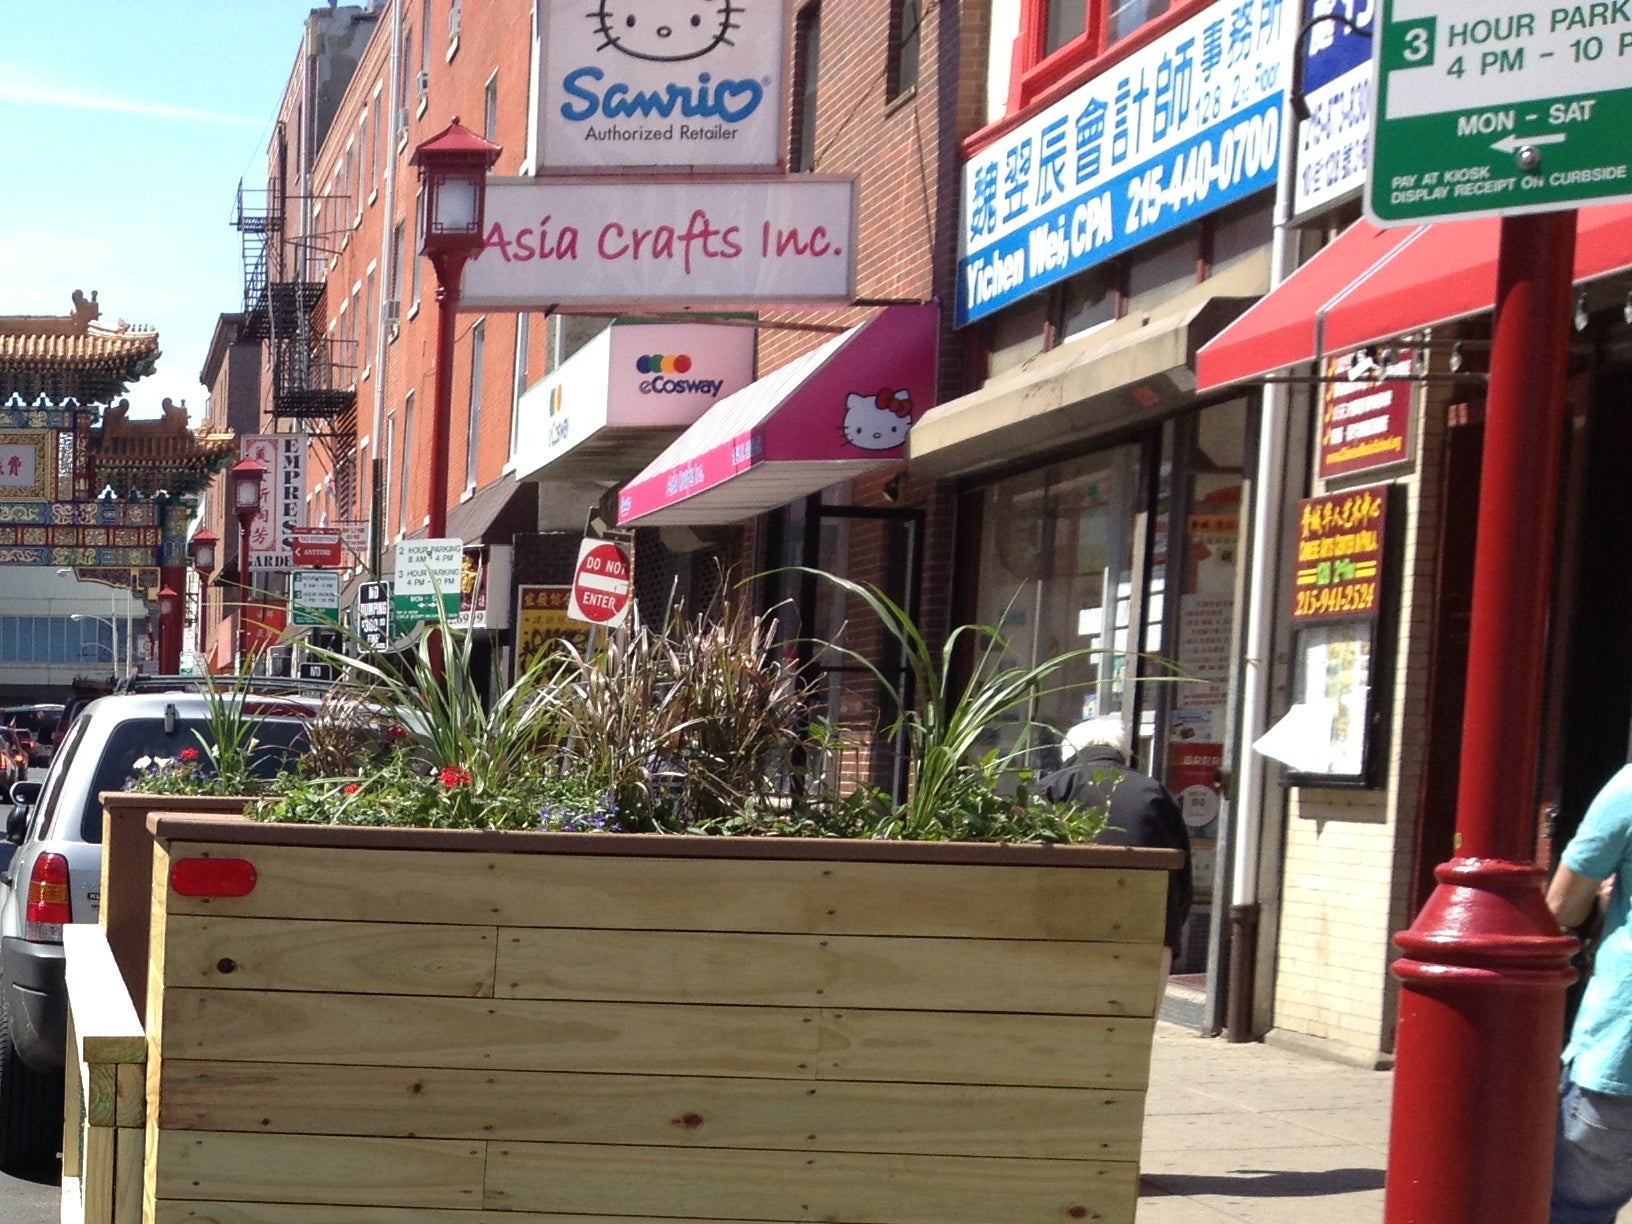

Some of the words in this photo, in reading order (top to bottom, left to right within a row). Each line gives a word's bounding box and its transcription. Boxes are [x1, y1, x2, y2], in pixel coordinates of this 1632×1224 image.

[1403, 28, 1429, 61] 3
[1448, 13, 1536, 48] HOUR
[1447, 56, 1466, 79] 4
[1480, 47, 1525, 76] PM
[1569, 36, 1603, 63] 10
[560, 66, 764, 123] Sanrio
[584, 125, 673, 141] Authorized
[679, 123, 738, 141] Retailer
[1457, 109, 1516, 137] MON
[1548, 99, 1597, 125] SAT
[1391, 186, 1449, 205] DISPLAY
[1453, 178, 1517, 197] RECEIPT
[1520, 175, 1545, 190] ON
[1549, 165, 1628, 187] CURBSIDE
[1392, 174, 1418, 189] PAY
[1421, 171, 1439, 186] AT
[1443, 166, 1492, 184] KIOSK
[967, 249, 1025, 309] Yichen
[1029, 214, 1069, 279] Wei,
[1071, 192, 1114, 258] CPA
[1125, 106, 1280, 235] 215-440-0700
[469, 215, 579, 262] Asia
[597, 209, 743, 274] Crafts
[762, 220, 842, 257] Inc.
[638, 376, 724, 397] eCosway
[408, 546, 428, 554] HOUR
[431, 545, 461, 553] PARKING
[586, 556, 601, 570] DO
[605, 561, 627, 575] NOT
[407, 569, 426, 577] HOUR
[444, 577, 455, 585] PM
[583, 592, 616, 609] ENTER
[1294, 583, 1376, 616] 215-941-2524
